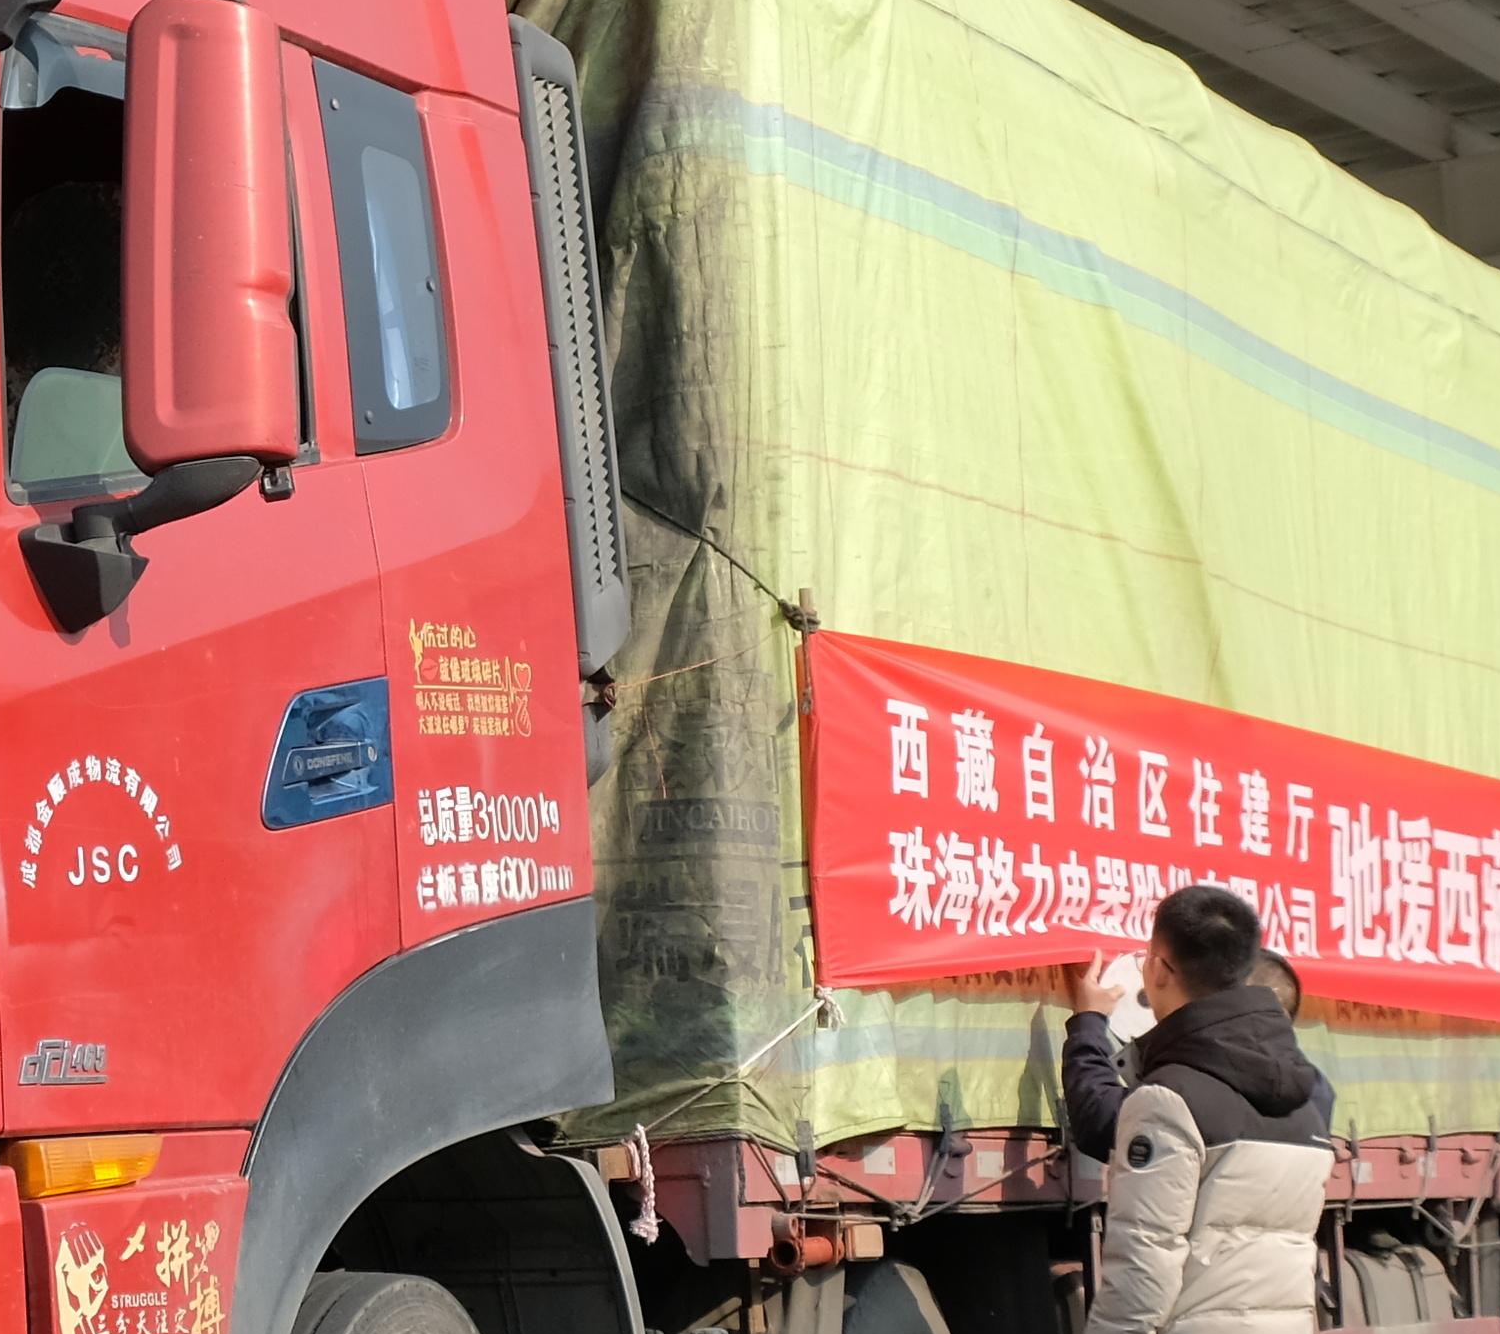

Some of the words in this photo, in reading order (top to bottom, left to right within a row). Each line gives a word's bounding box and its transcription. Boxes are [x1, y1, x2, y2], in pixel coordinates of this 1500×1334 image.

[886, 698, 1316, 863] 西藏自治区住建厅
[68, 843, 139, 886] JSC
[111, 1291, 168, 1309] STRUGGLE
